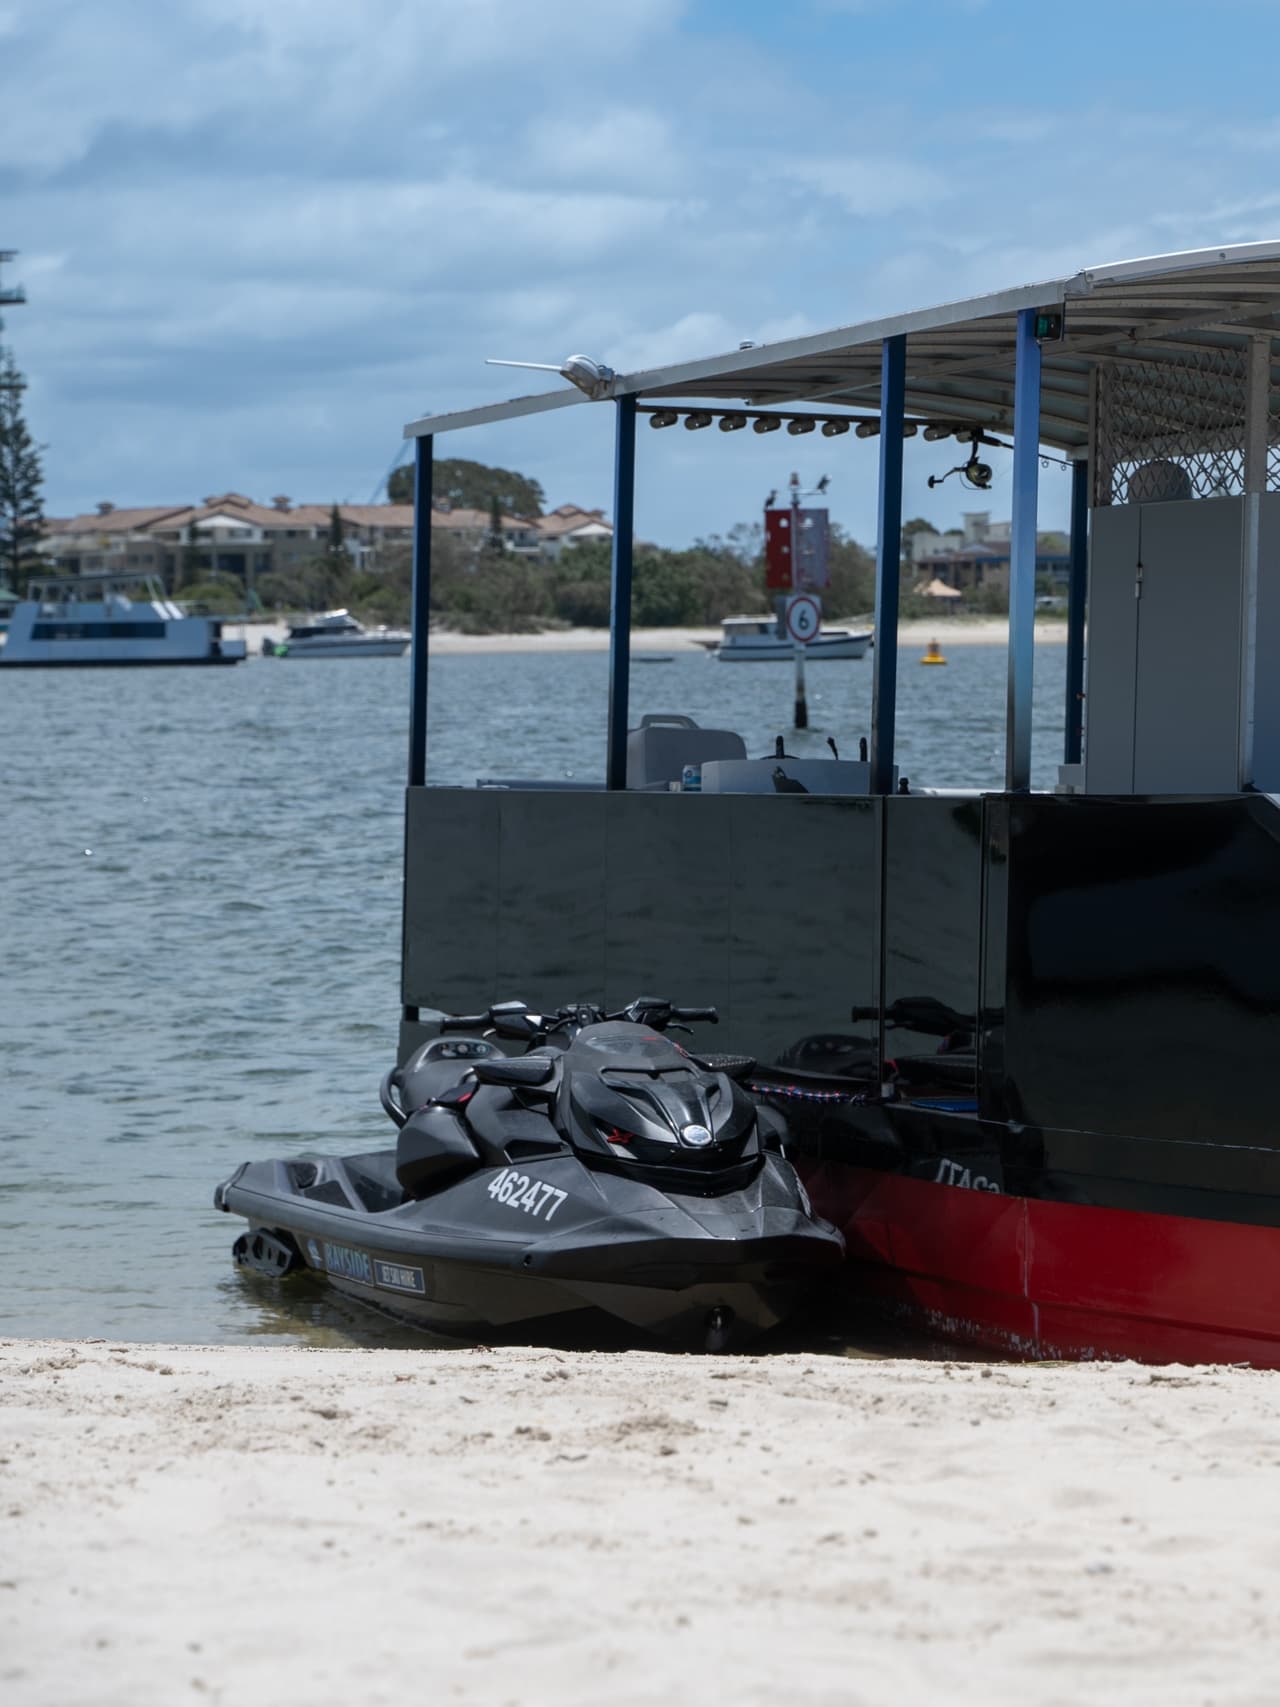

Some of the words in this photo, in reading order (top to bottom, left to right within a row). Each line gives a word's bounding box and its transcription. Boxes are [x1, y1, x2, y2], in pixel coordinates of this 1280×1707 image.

[797, 610, 810, 630] 6
[488, 1168, 569, 1222] 462477
[324, 1243, 371, 1281] BAYSIDE
